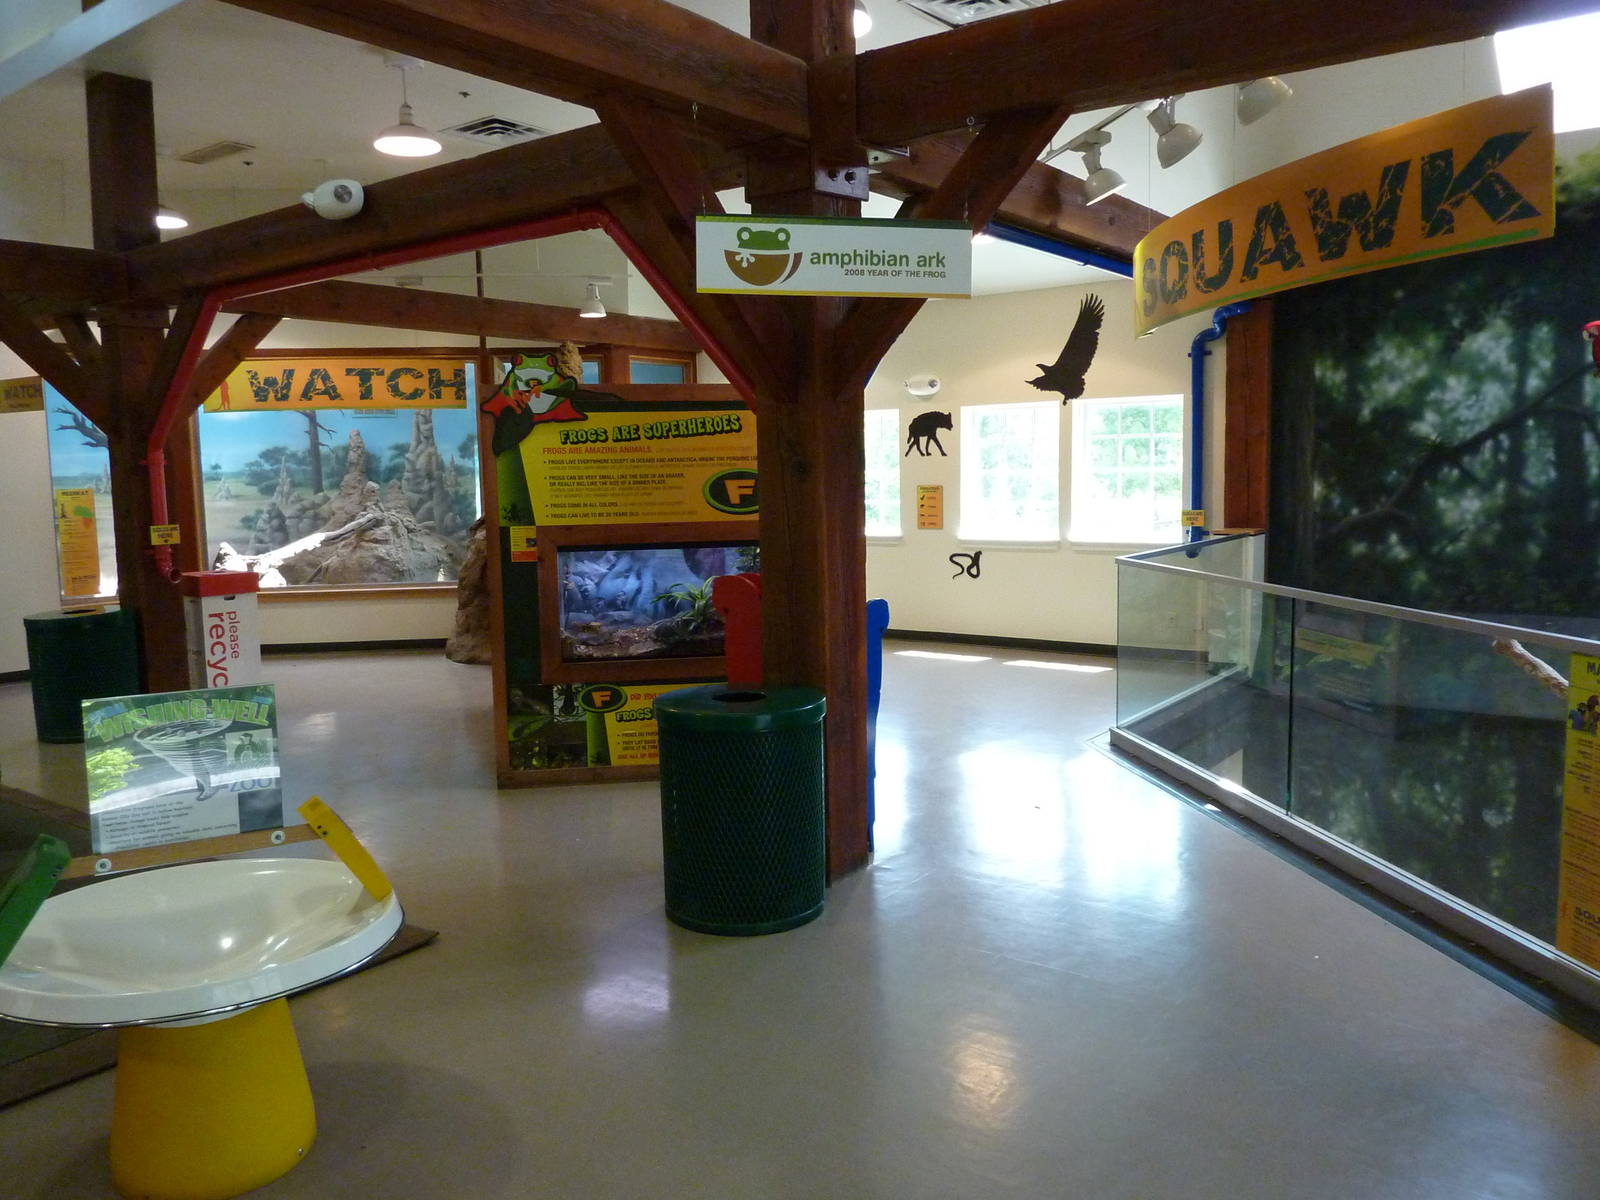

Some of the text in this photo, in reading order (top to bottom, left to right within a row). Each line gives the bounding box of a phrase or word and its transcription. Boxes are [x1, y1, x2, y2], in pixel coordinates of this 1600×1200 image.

[1142, 126, 1543, 317] SQUAWK
[810, 249, 946, 269] amphibian ark
[844, 269, 946, 279] 2008 YEAR OF THE FROG
[246, 368, 467, 402] WATCH
[559, 414, 742, 446] FROGS ARE SUPERHEROES
[724, 479, 756, 505] F
[207, 612, 229, 688] recyc
[226, 610, 240, 659] please
[592, 691, 611, 708] F
[616, 708, 653, 723] FROGS
[95, 699, 273, 743] WISHING WELL
